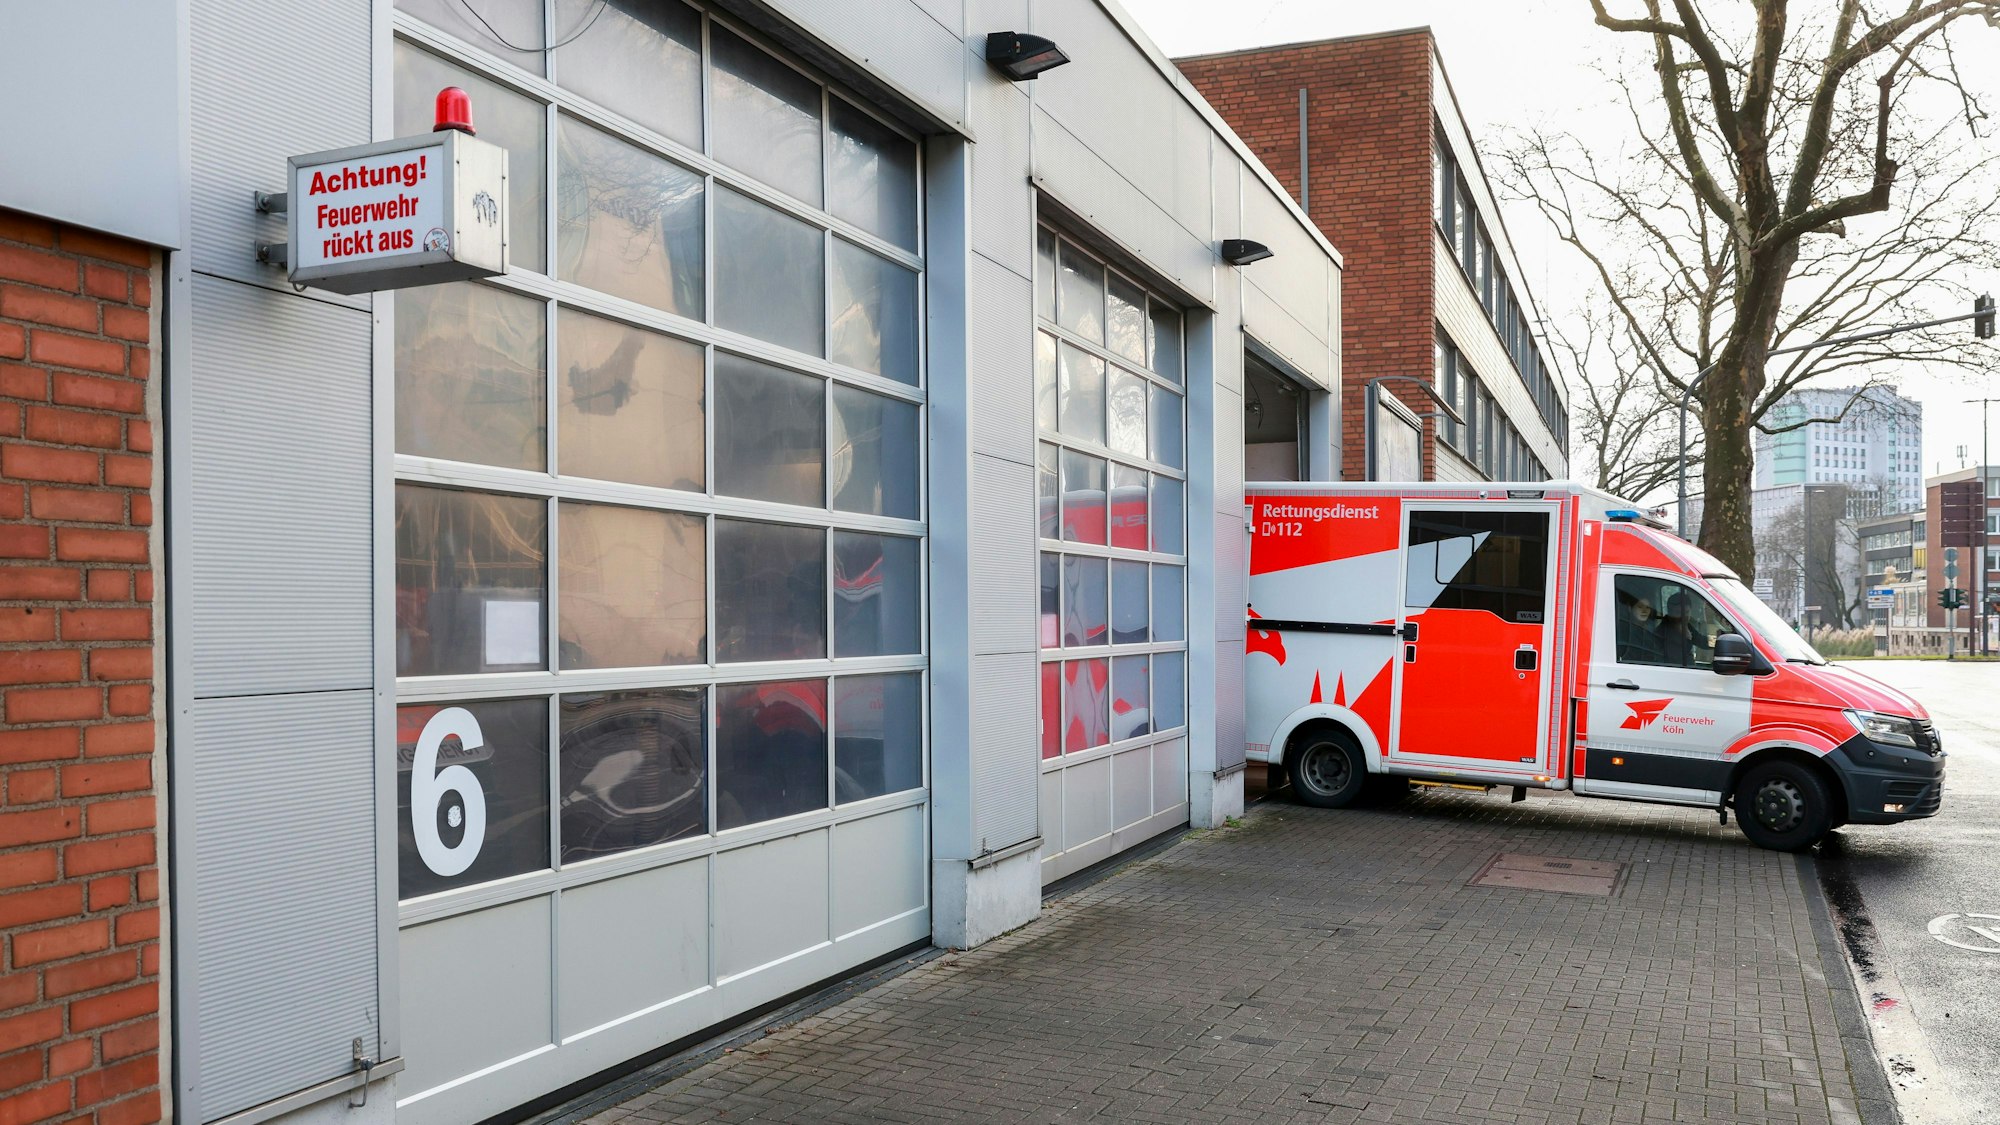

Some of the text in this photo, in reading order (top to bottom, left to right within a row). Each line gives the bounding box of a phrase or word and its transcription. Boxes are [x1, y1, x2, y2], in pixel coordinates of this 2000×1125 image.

[309, 155, 427, 196] Achtung!
[317, 194, 419, 229] Feuerwehr
[323, 229, 413, 259] rückt aus
[1263, 503, 1379, 522] Rettungsdienst
[1277, 522, 1303, 537] 112
[1662, 725, 1684, 734] Köln
[1663, 714, 1715, 725] Feuerwehr
[411, 707, 486, 877] 6
